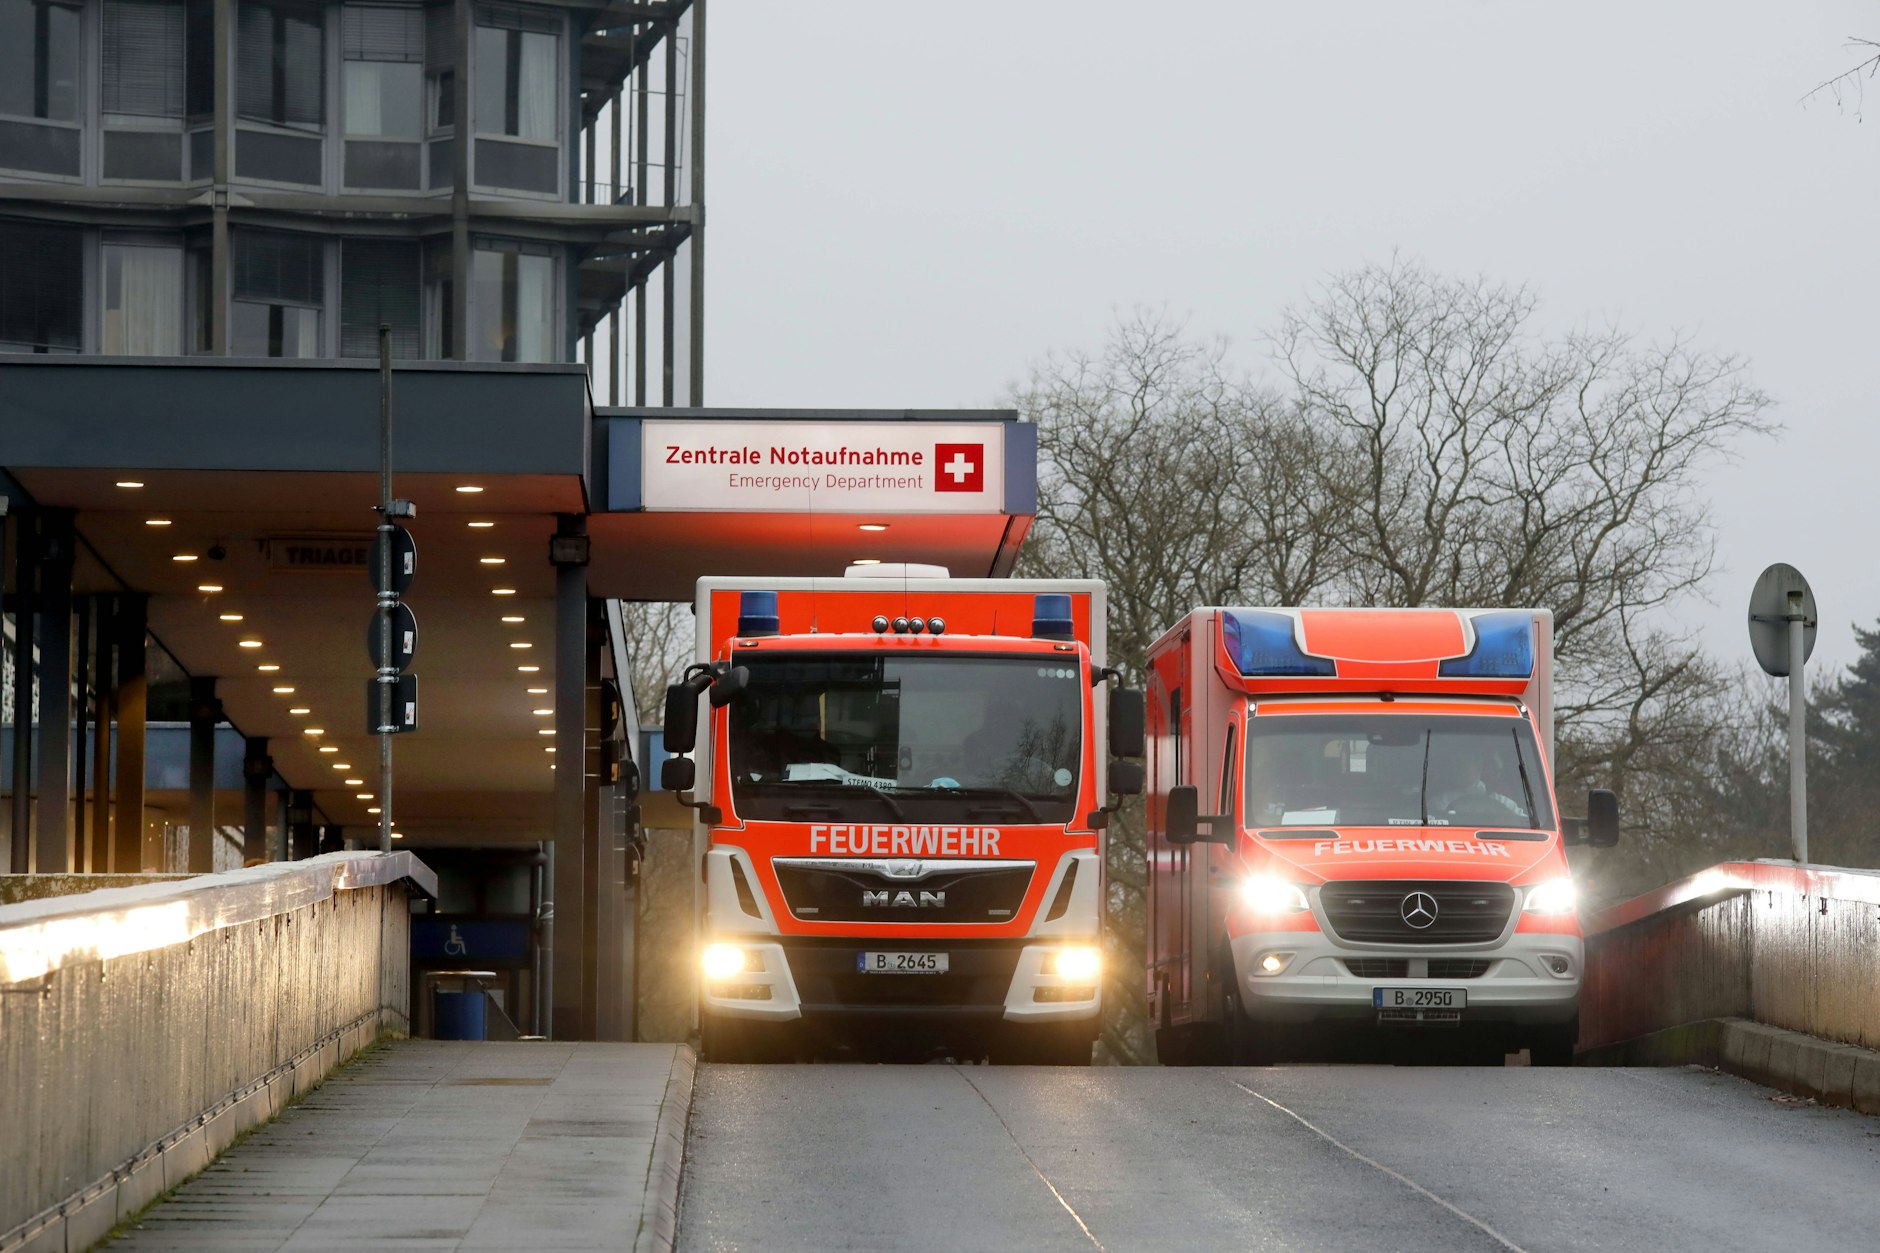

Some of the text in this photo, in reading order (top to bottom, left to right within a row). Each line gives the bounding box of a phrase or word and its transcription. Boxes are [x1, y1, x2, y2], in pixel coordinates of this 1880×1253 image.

[665, 445, 923, 465] Zentrale Notaufnahme
[728, 473, 923, 491] Emergency Department
[286, 546, 368, 565] TRIAGE
[810, 826, 1000, 855] FEUERWEHR
[1314, 839, 1510, 857] FEUERWEHR
[863, 890, 946, 907] MAN
[876, 954, 887, 969] B
[896, 954, 936, 969] 2645
[1394, 990, 1453, 1006] B 2950
